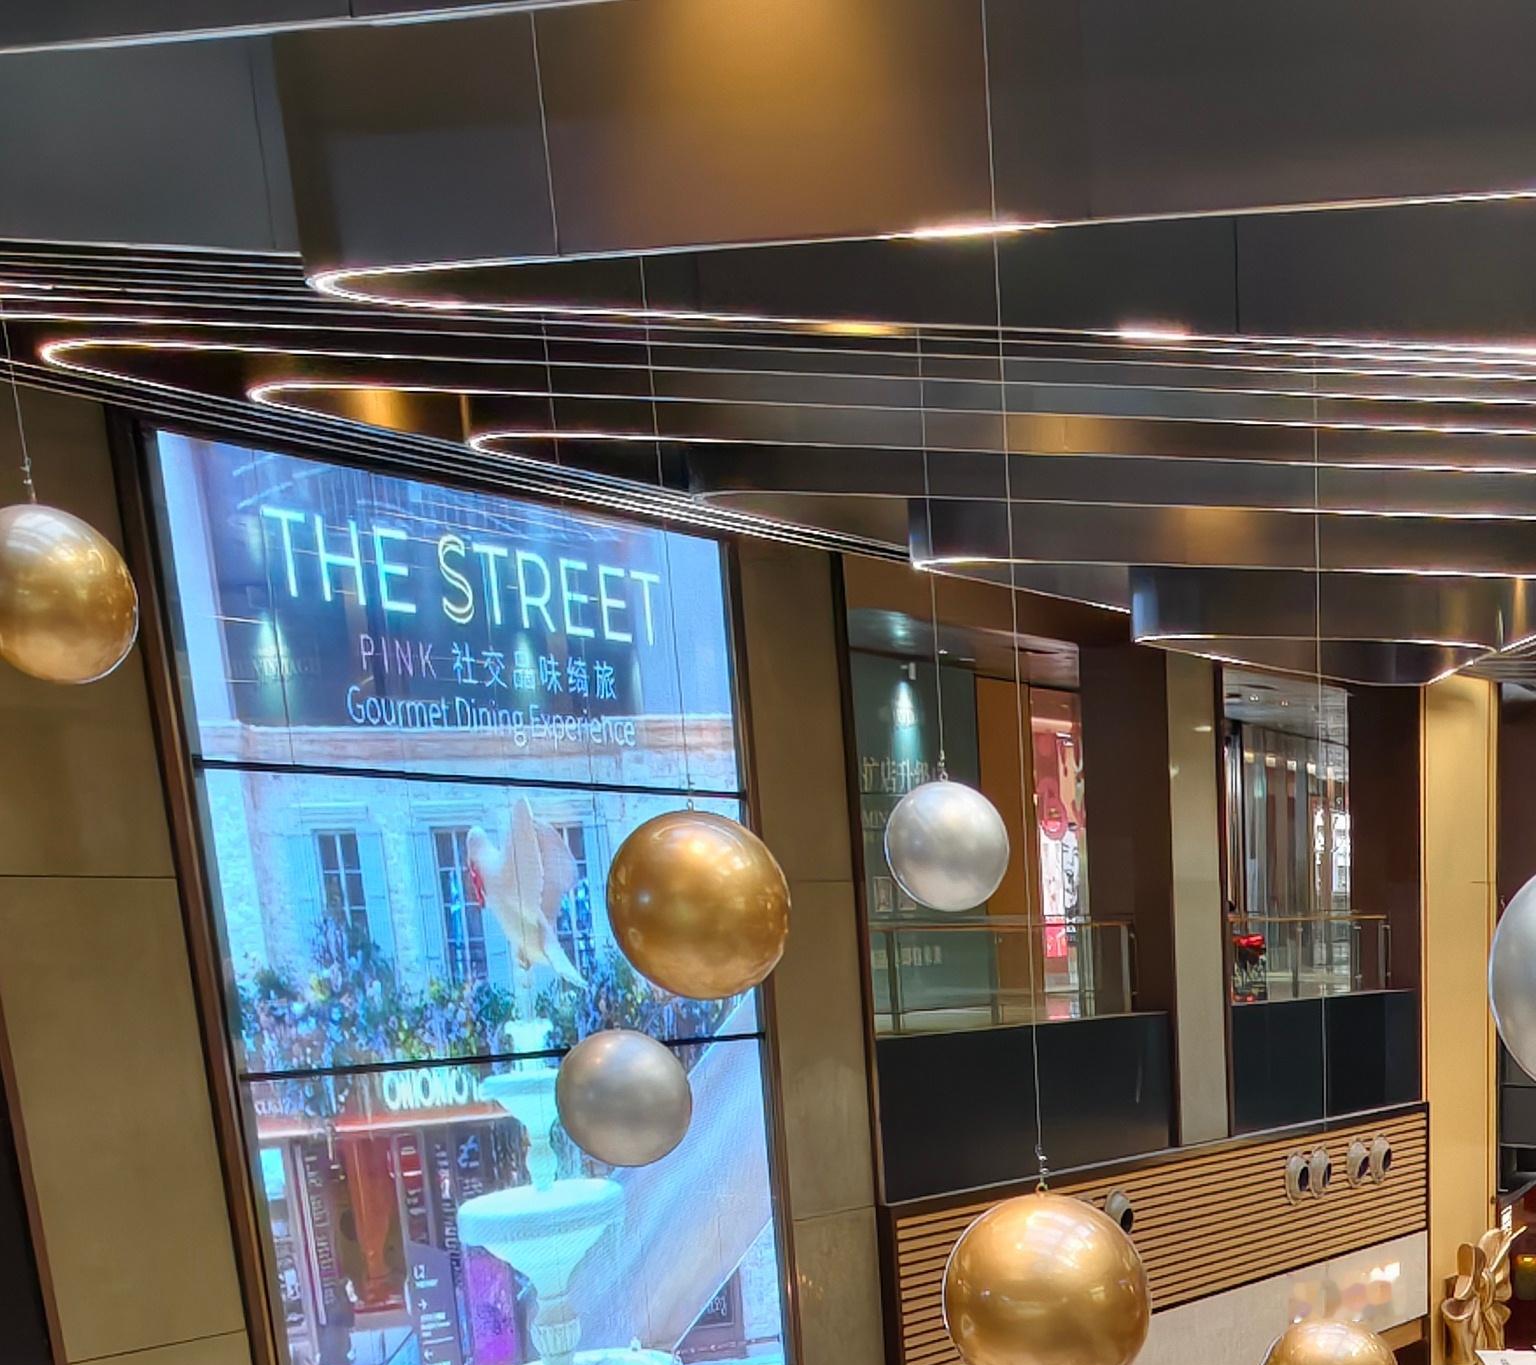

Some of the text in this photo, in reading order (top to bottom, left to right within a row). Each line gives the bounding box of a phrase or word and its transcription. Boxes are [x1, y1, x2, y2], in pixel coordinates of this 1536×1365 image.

[261, 507, 660, 646] THE STREET
[360, 633, 437, 679] PINK
[347, 684, 636, 750] Gourmet Dining Experience
